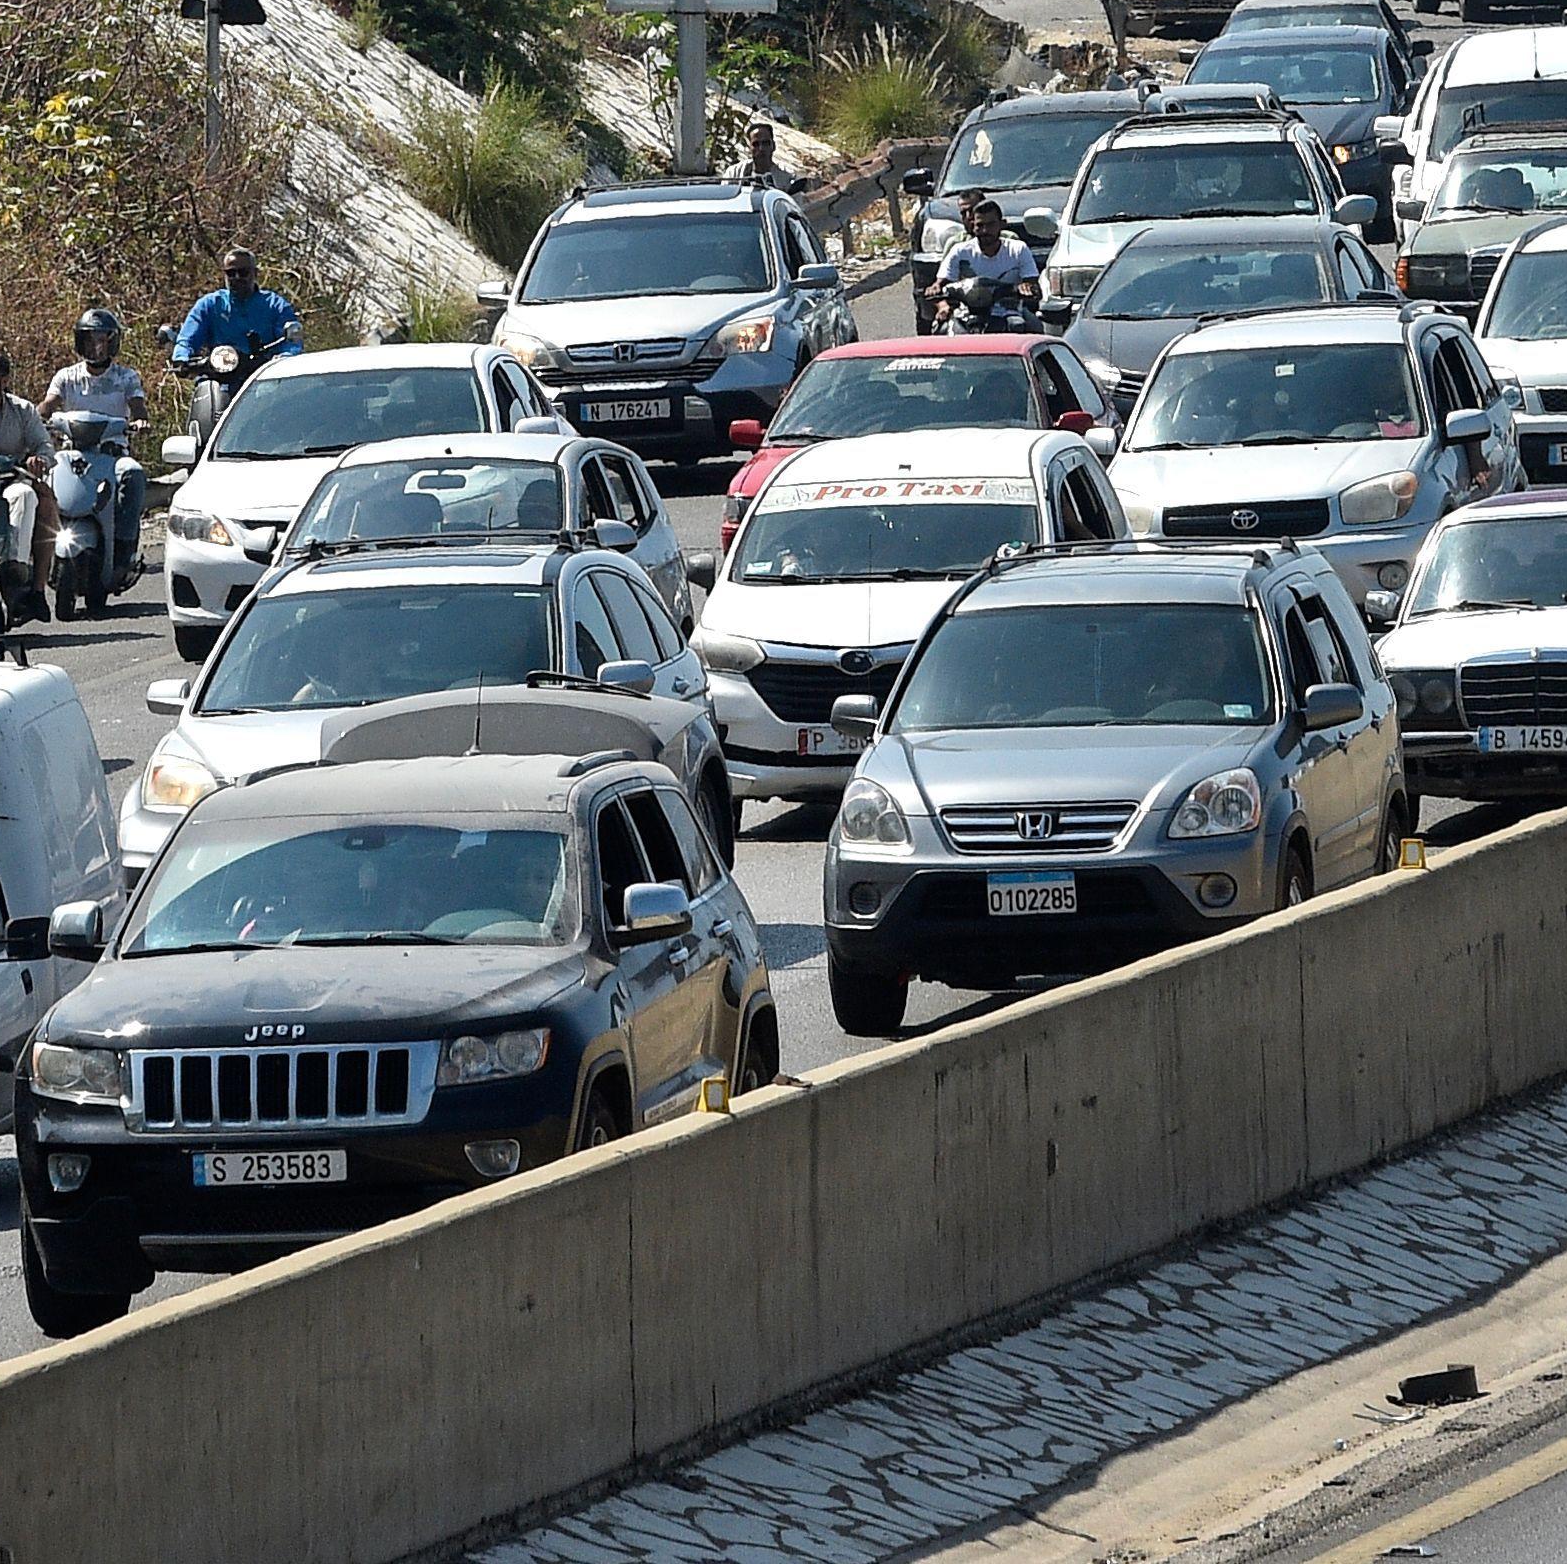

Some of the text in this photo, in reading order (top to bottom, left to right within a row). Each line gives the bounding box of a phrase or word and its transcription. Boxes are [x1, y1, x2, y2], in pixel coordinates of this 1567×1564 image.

[590, 401, 660, 421] N 176241
[812, 483, 885, 501] Pro
[897, 480, 987, 498] Taxi
[813, 732, 825, 751] P
[1494, 729, 1506, 749] B
[245, 1024, 306, 1042] Jeep
[212, 1153, 332, 1182] S 253583
